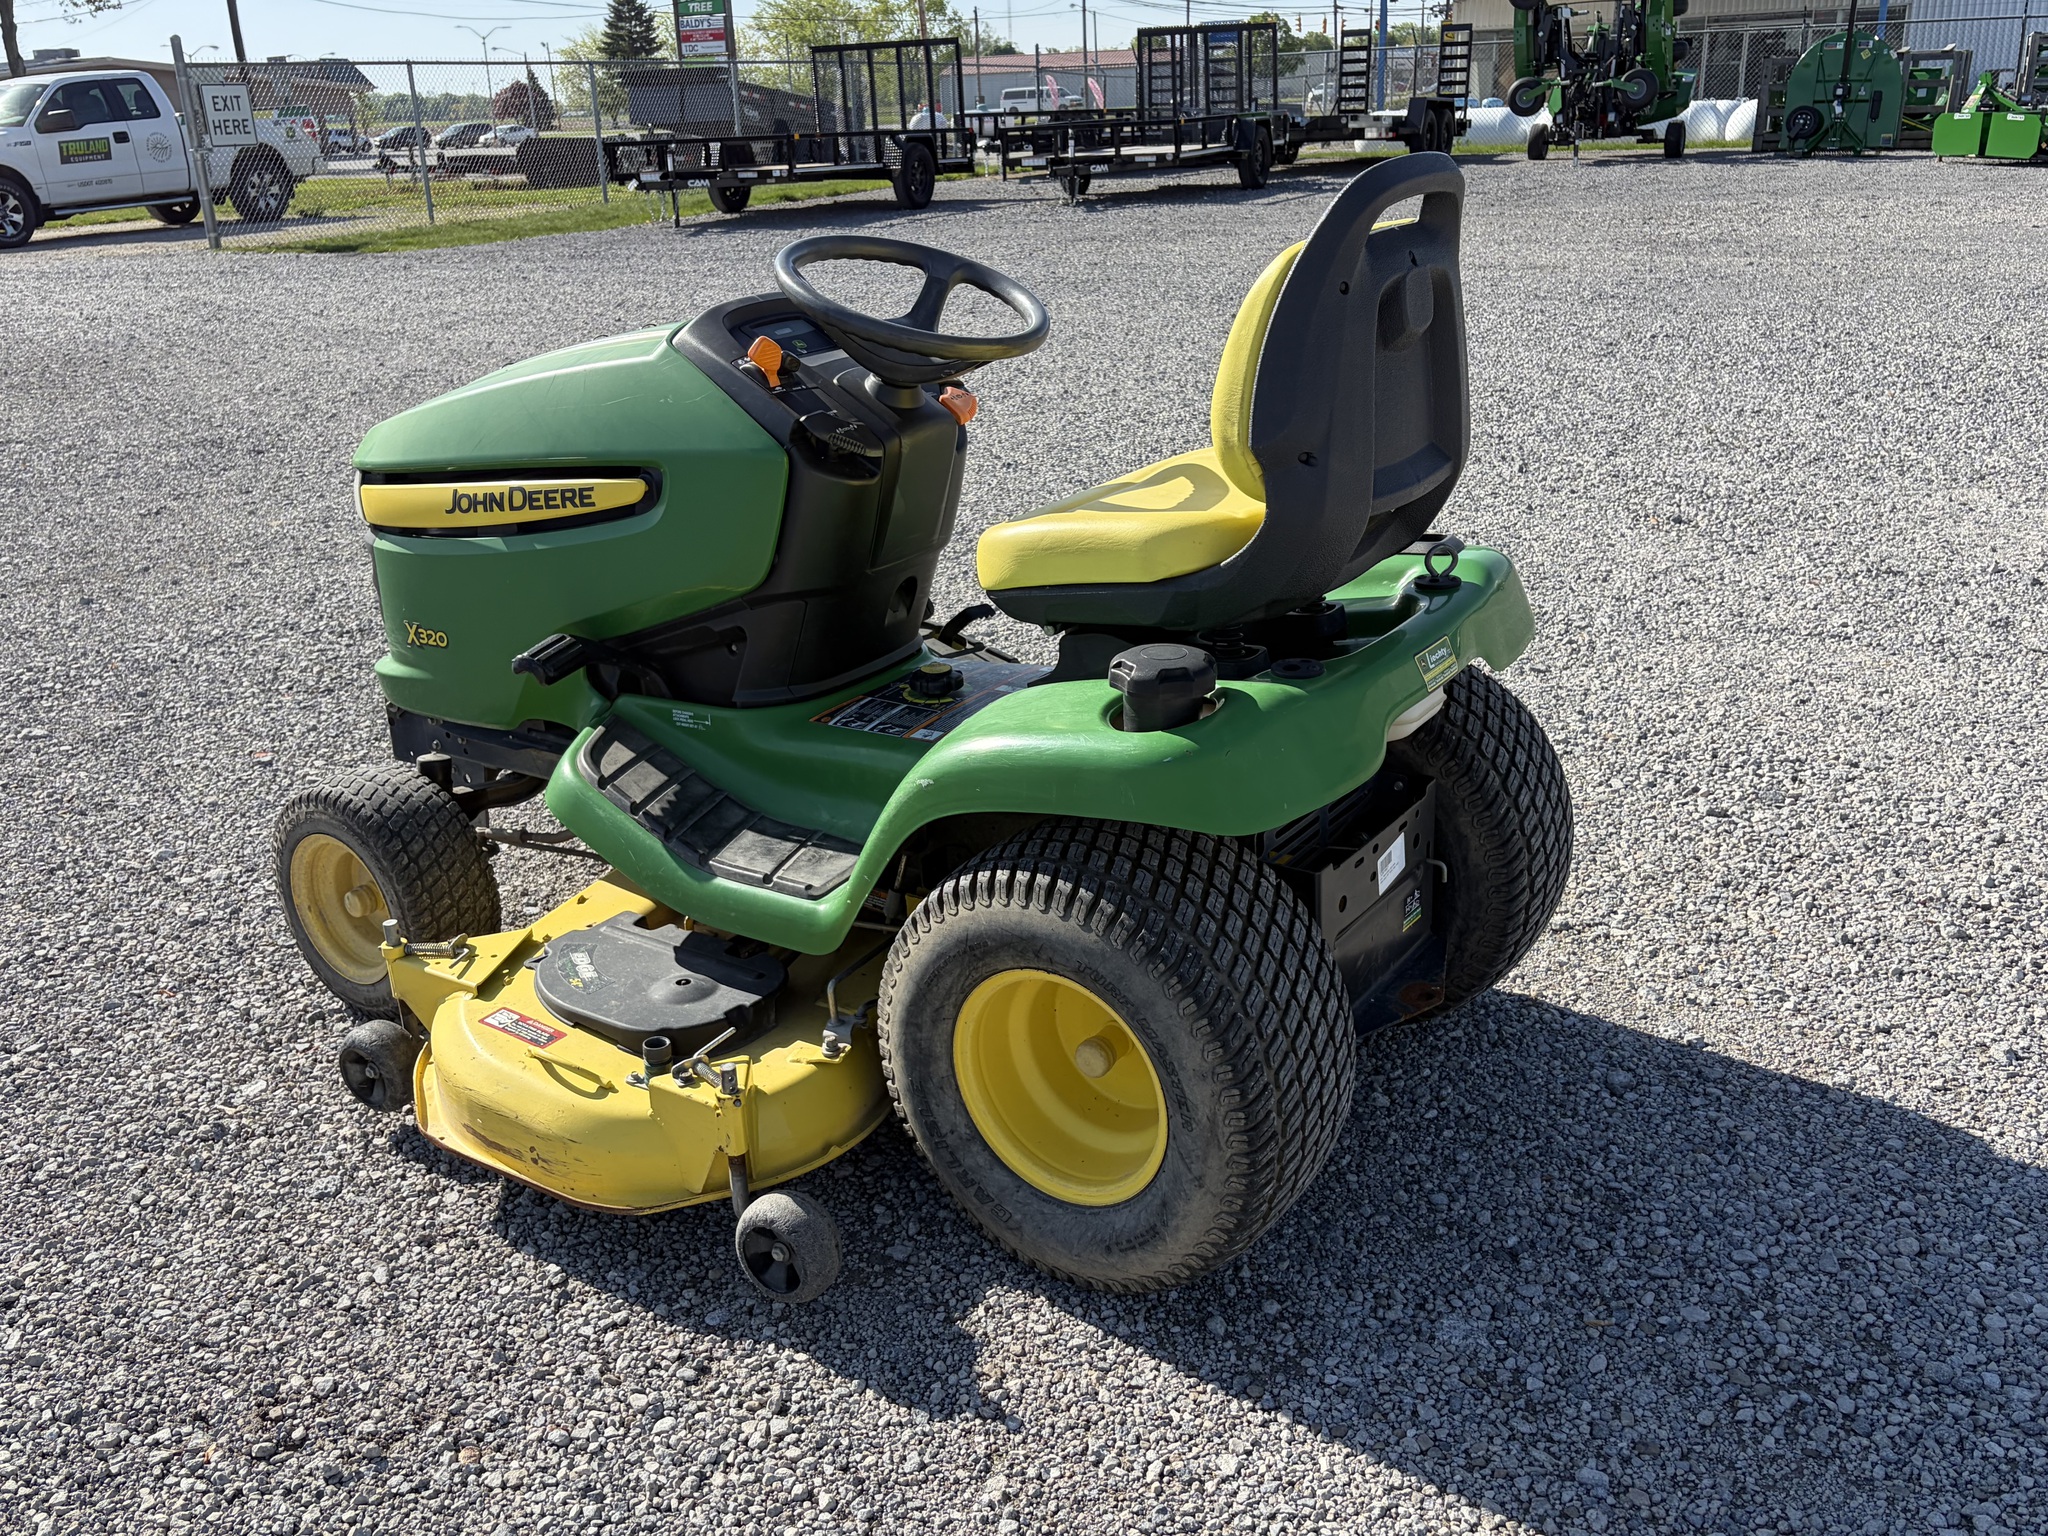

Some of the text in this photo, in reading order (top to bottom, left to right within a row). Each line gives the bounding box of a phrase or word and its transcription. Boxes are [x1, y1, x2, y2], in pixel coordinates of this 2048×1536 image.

[688, 1, 713, 13] TREE
[680, 18, 712, 29] BALDY'S
[684, 44, 699, 53] TDC
[211, 95, 242, 112] EXIT
[212, 118, 252, 136] HERE
[60, 139, 109, 157] TRULAND
[70, 155, 106, 163] EQUIPMENT
[1089, 163, 1109, 173] CAM
[687, 178, 711, 188] CAM
[445, 486, 596, 515] JOHN DEERE
[403, 620, 449, 649] X320
[569, 950, 599, 982] EDGE
[532, 1020, 555, 1033] DANGER
[1076, 959, 1195, 1133] TURF MASTER
